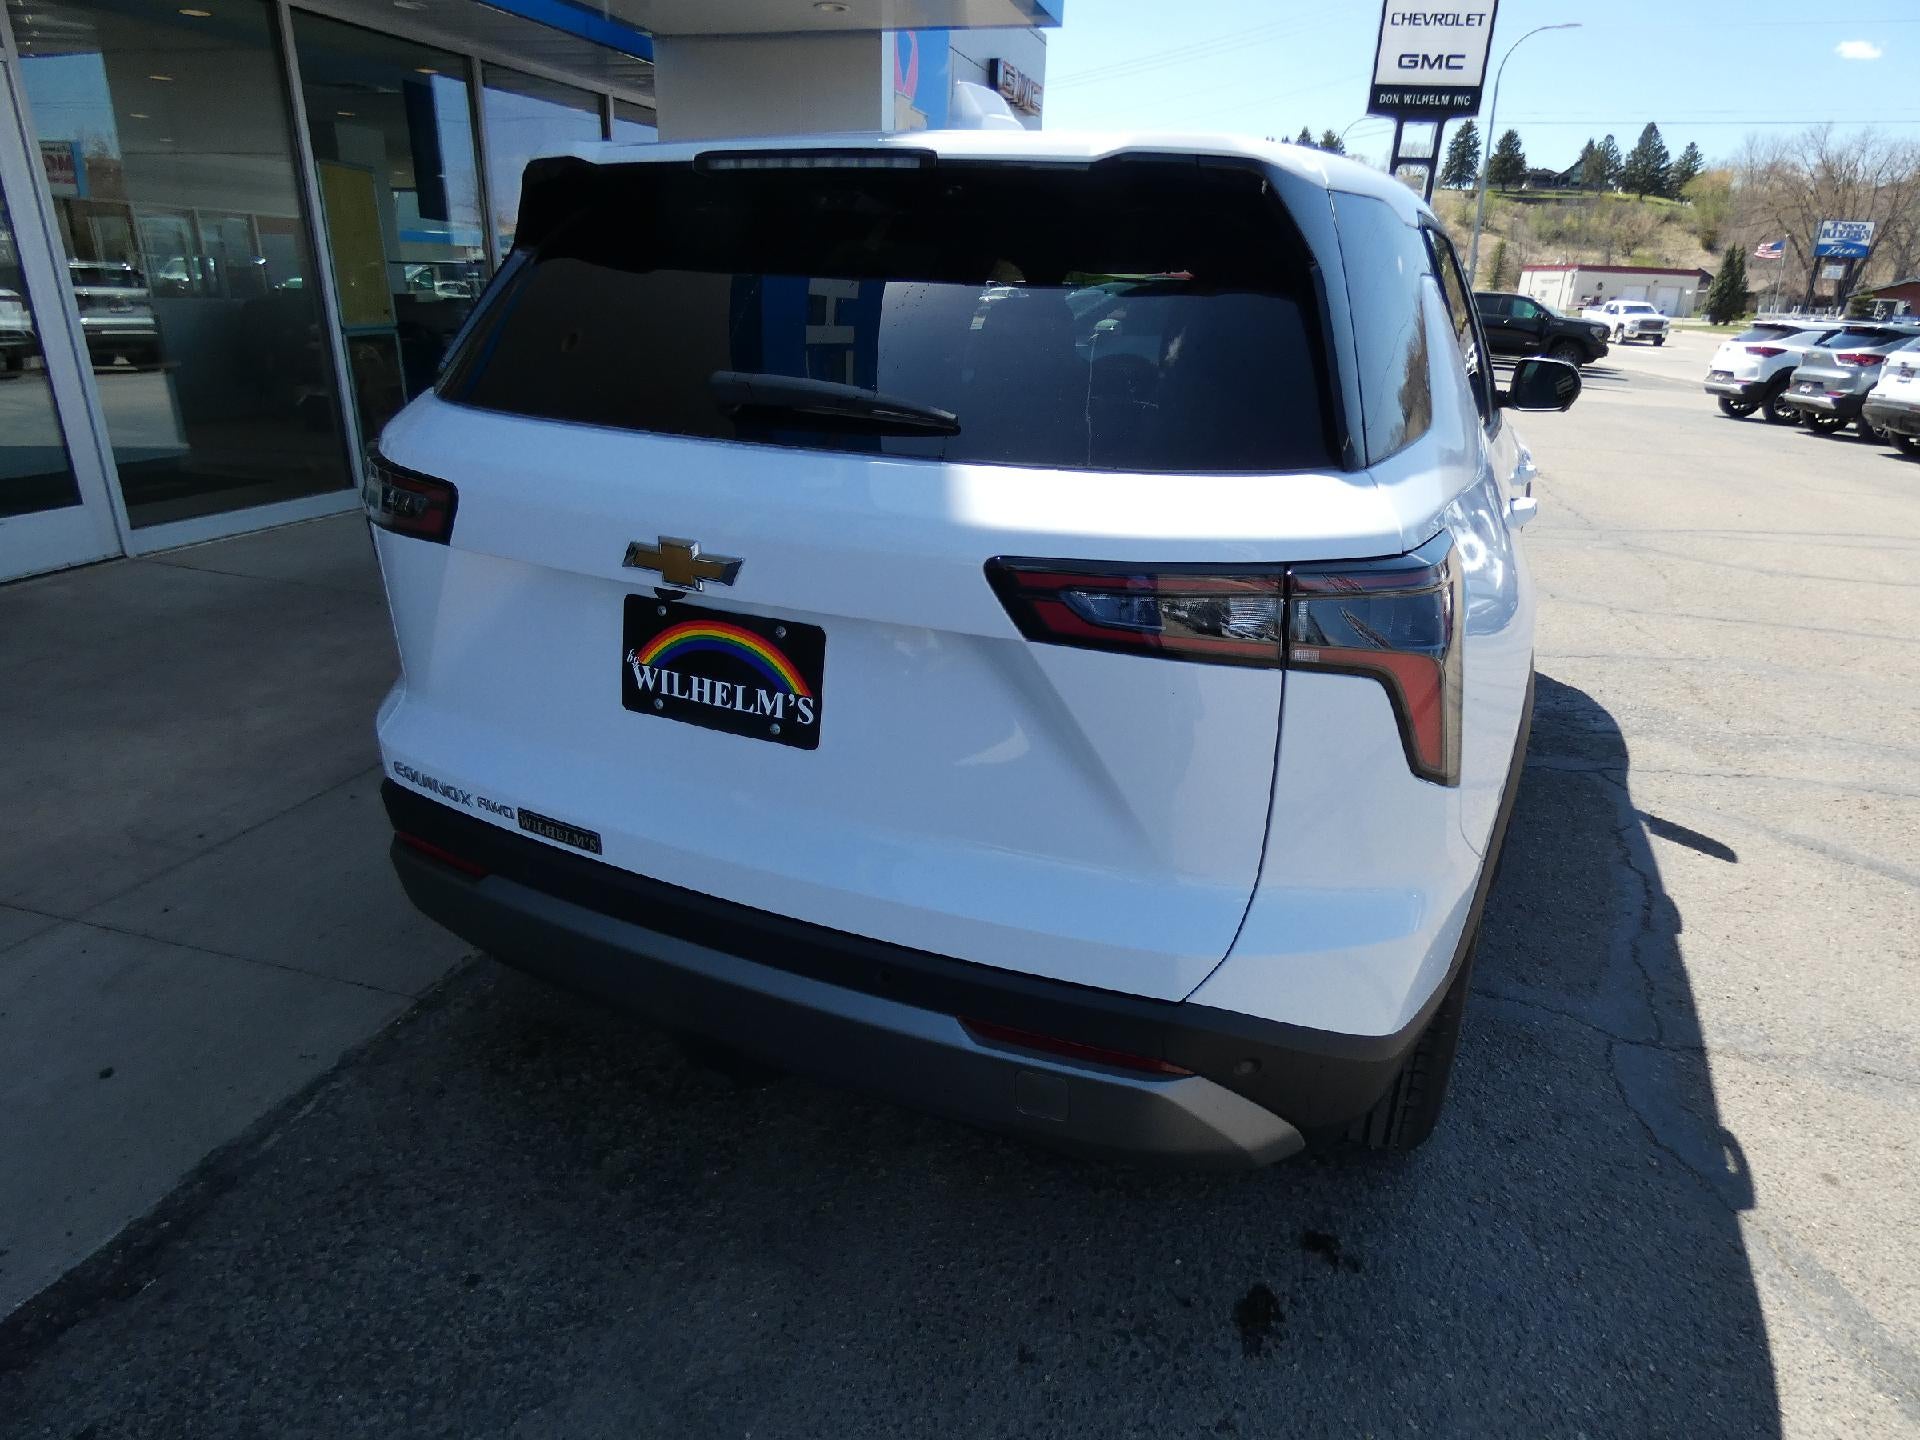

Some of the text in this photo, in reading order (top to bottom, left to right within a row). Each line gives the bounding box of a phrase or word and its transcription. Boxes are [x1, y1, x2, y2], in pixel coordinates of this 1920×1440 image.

[1391, 12, 1486, 27] CHEVROLET
[1398, 53, 1466, 71] GMC
[1379, 93, 1471, 106] DON WILHELM INC
[631, 662, 815, 726] WILHELM'S
[393, 760, 516, 820] EQUINOX AWD
[518, 815, 600, 852] WILHELM'S
